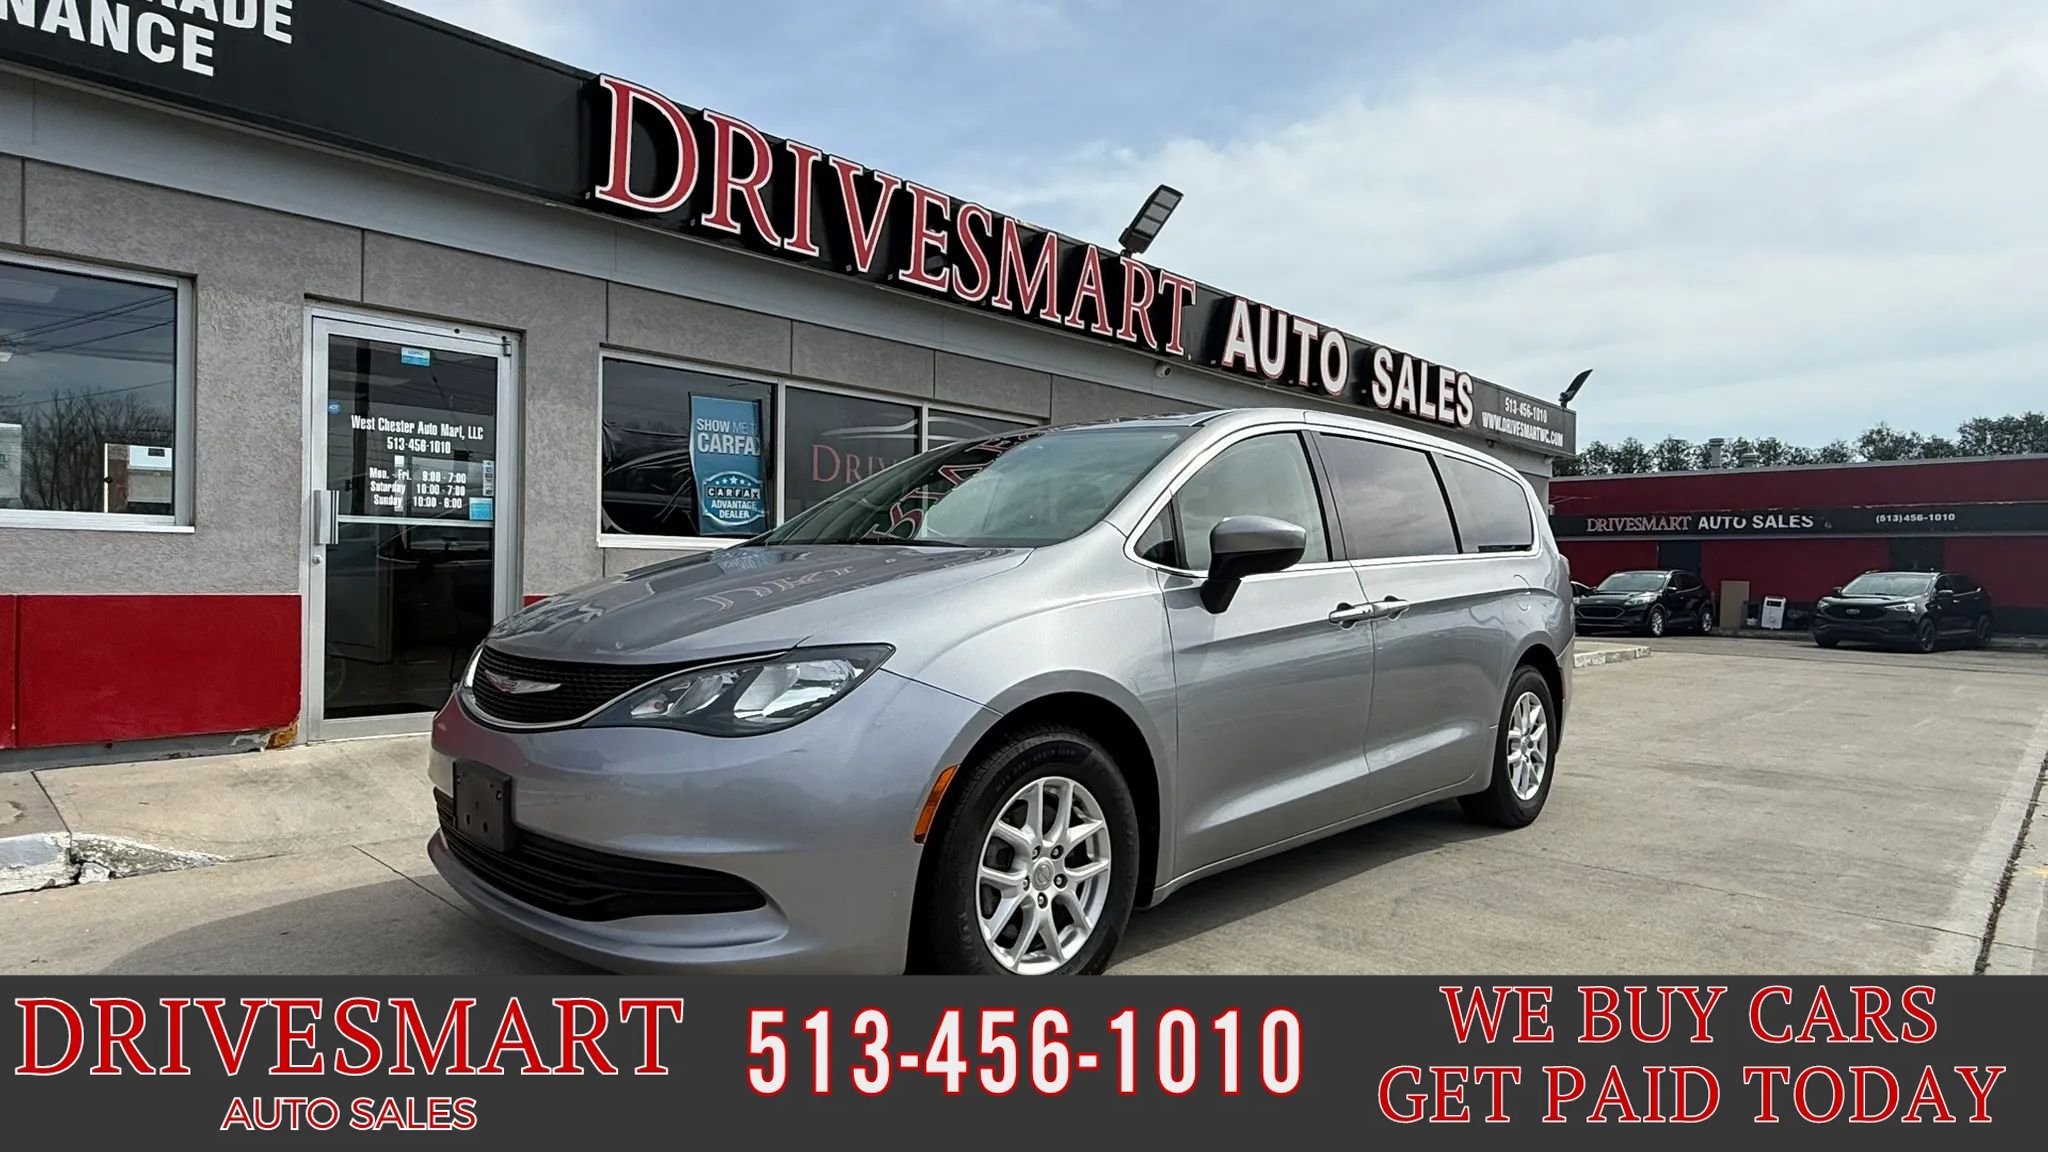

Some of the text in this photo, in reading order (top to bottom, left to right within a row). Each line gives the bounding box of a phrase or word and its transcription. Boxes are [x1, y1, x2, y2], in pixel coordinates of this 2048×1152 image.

[147, 0, 293, 44] ADE
[596, 73, 1474, 427] DRIVESMART AUTO SALES
[1504, 396, 1548, 424] 513-456-1010
[351, 414, 484, 441] West Chester Auto Mart, LLC
[697, 418, 730, 434] SHOW
[732, 421, 748, 436] ME
[387, 436, 451, 454] 513-456-1010
[369, 467, 390, 480] Mon.
[398, 468, 413, 481] Fri.
[422, 470, 441, 483] 9:00
[448, 472, 467, 484] 7:00
[370, 481, 406, 495] Saturday
[416, 483, 440, 495] 10:00
[447, 485, 466, 497] 7:00
[708, 486, 761, 499] CARFAX
[373, 493, 403, 508] Sunday
[412, 496, 437, 508] 10:00
[711, 499, 758, 512] ADVANTAGE
[719, 509, 750, 519] DEALER
[1586, 514, 1814, 532] DRIVESMART AUTO SALES
